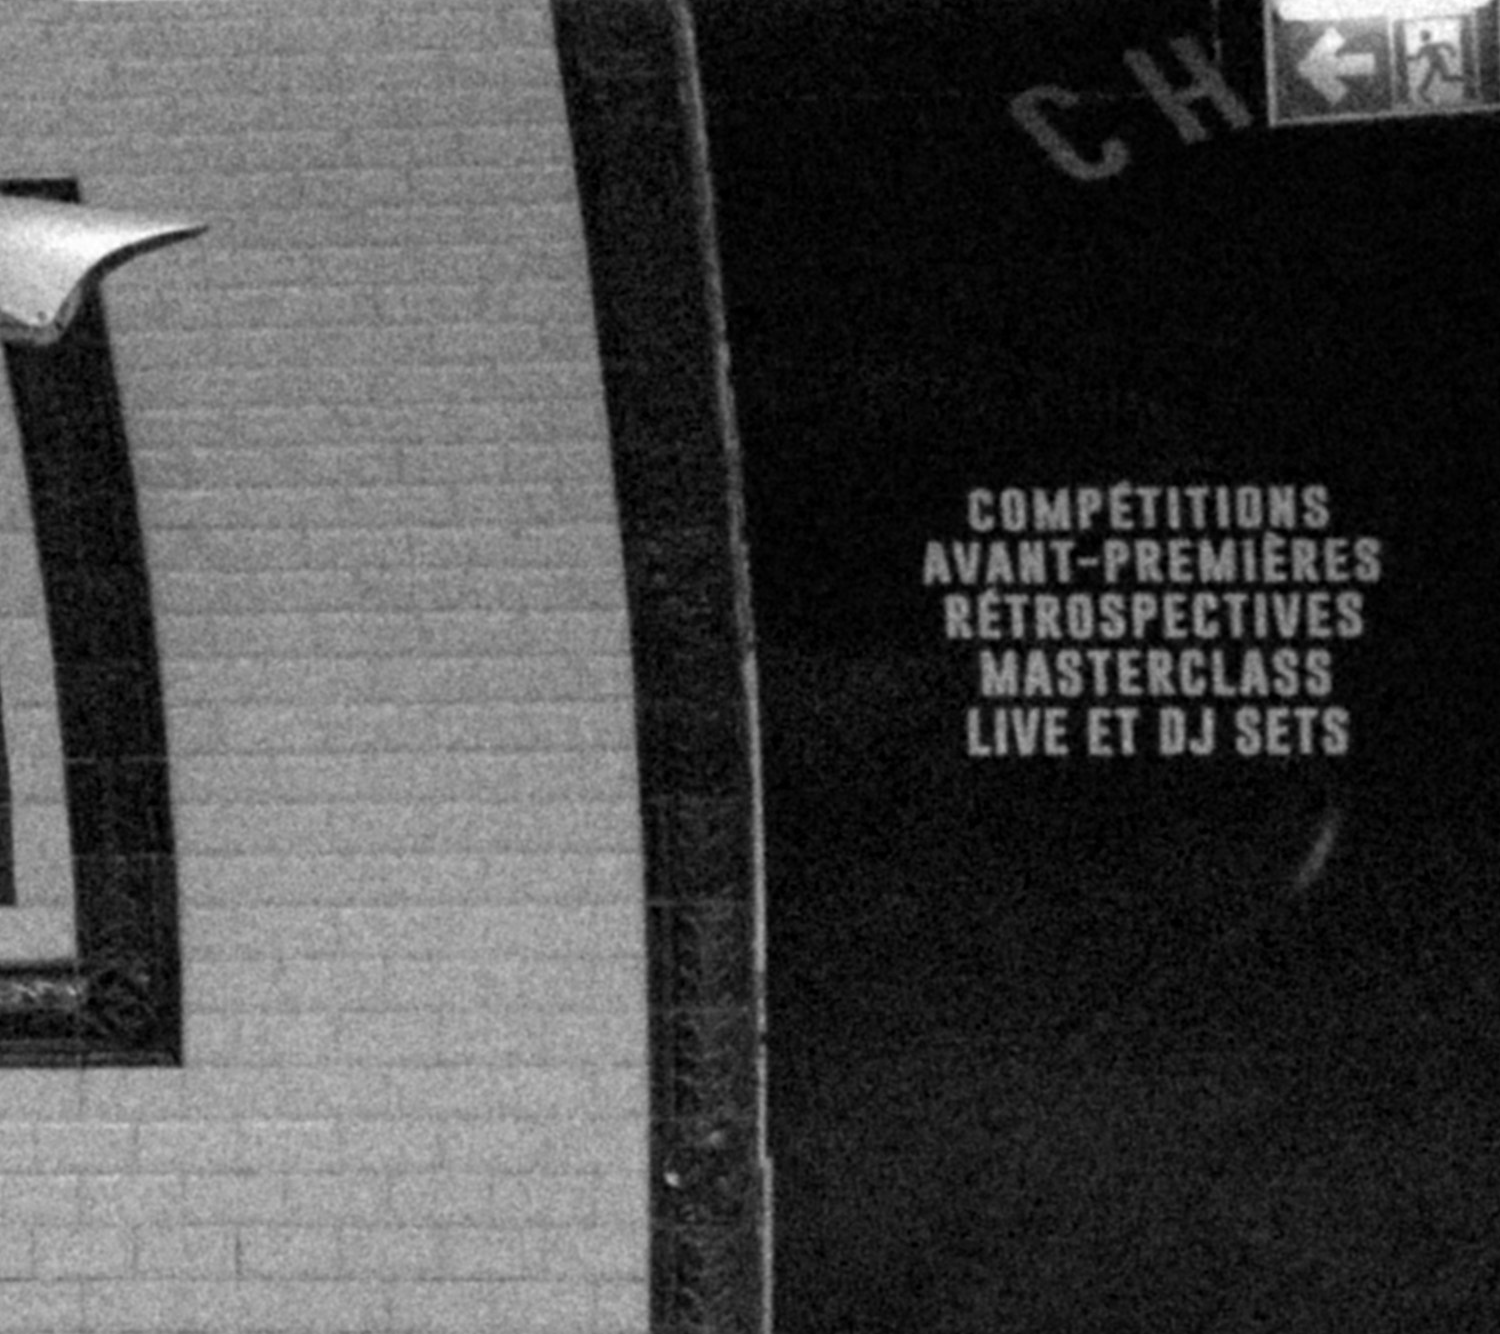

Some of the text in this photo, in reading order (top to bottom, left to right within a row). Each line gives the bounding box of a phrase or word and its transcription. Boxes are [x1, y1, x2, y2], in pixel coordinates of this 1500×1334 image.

[967, 480, 1331, 532] COMPÉTITIONS
[923, 531, 1382, 585] AVANT-PREMIÈRES
[944, 587, 1365, 640] RÉTROSPECTIVES
[979, 648, 1333, 697] MASTERCLASS
[966, 705, 1350, 757] LIVE ET DJ SETS
